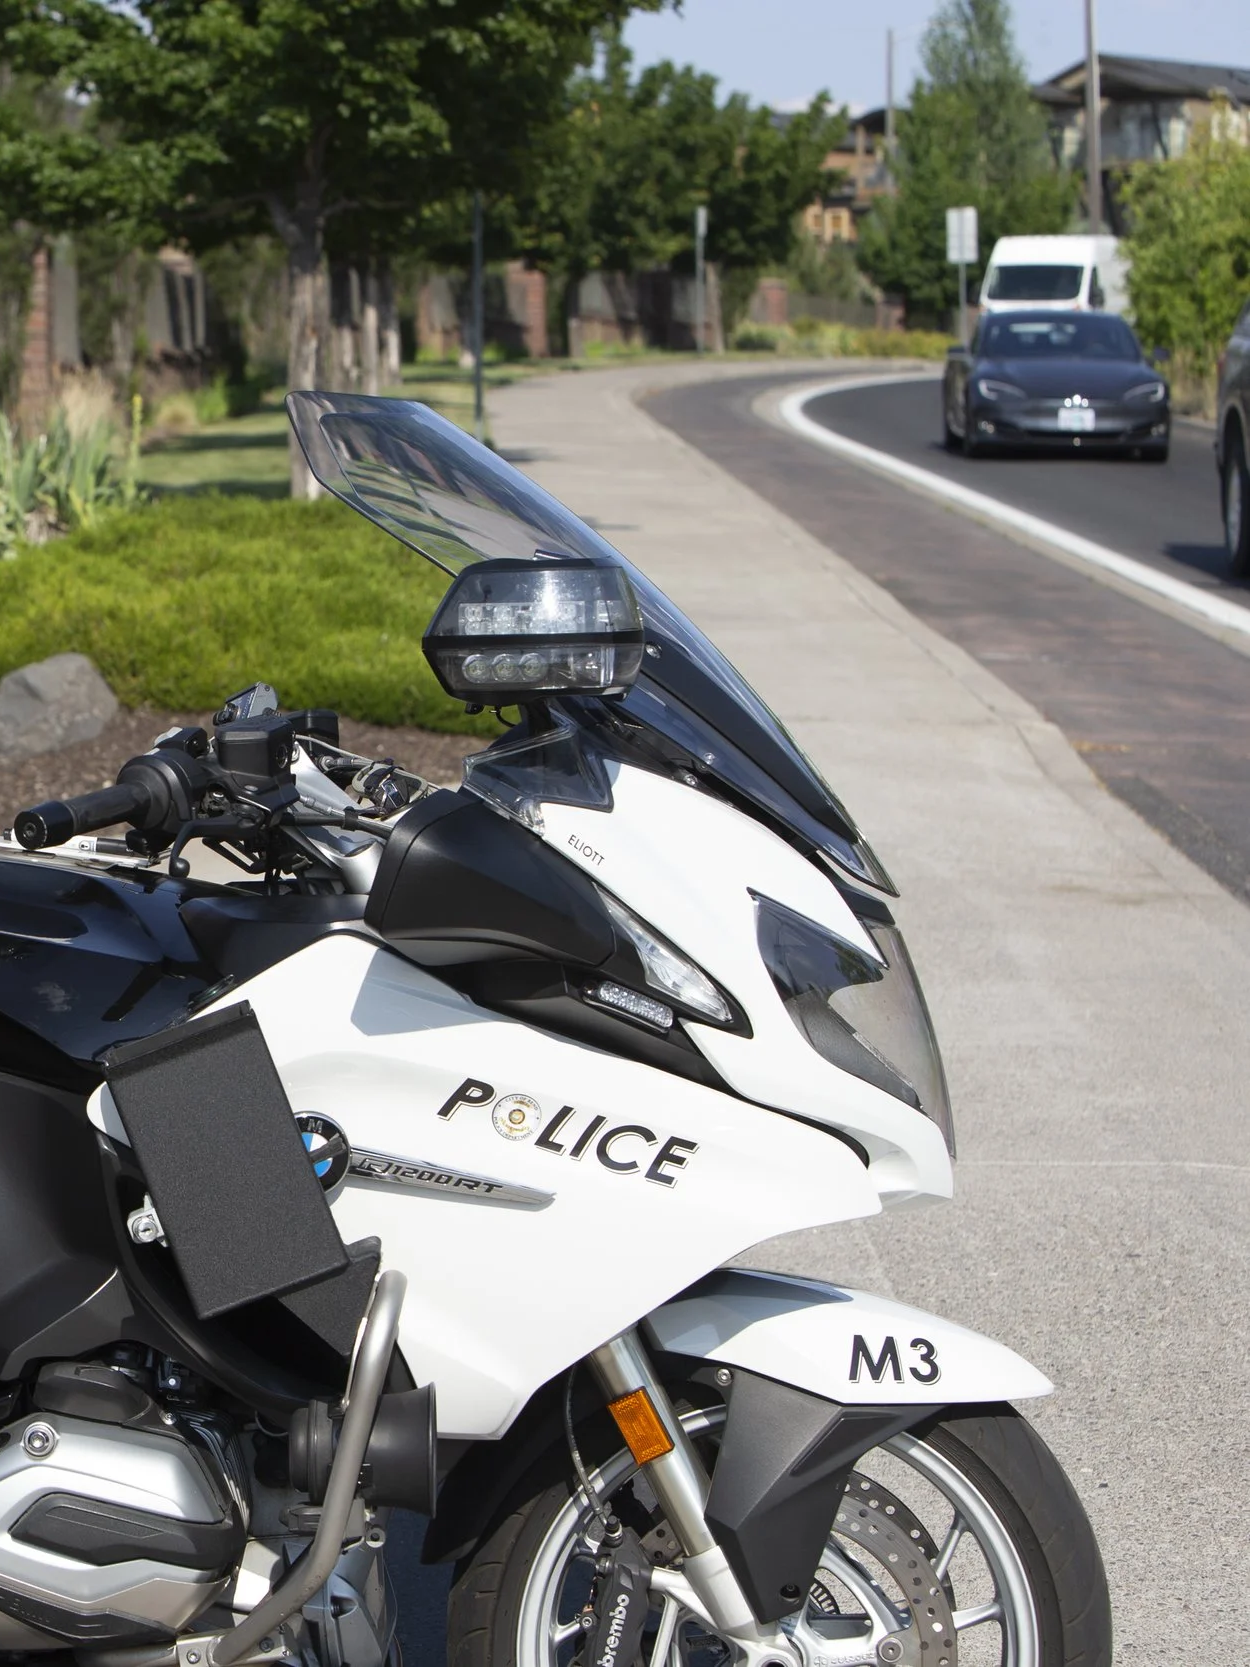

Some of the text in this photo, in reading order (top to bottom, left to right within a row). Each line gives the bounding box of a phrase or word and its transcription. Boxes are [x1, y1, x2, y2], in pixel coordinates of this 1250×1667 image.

[567, 834, 606, 866] ELIOTT
[437, 1077, 700, 1189] POLICE
[848, 1334, 942, 1386] M3
[597, 1593, 630, 1667] brembo
